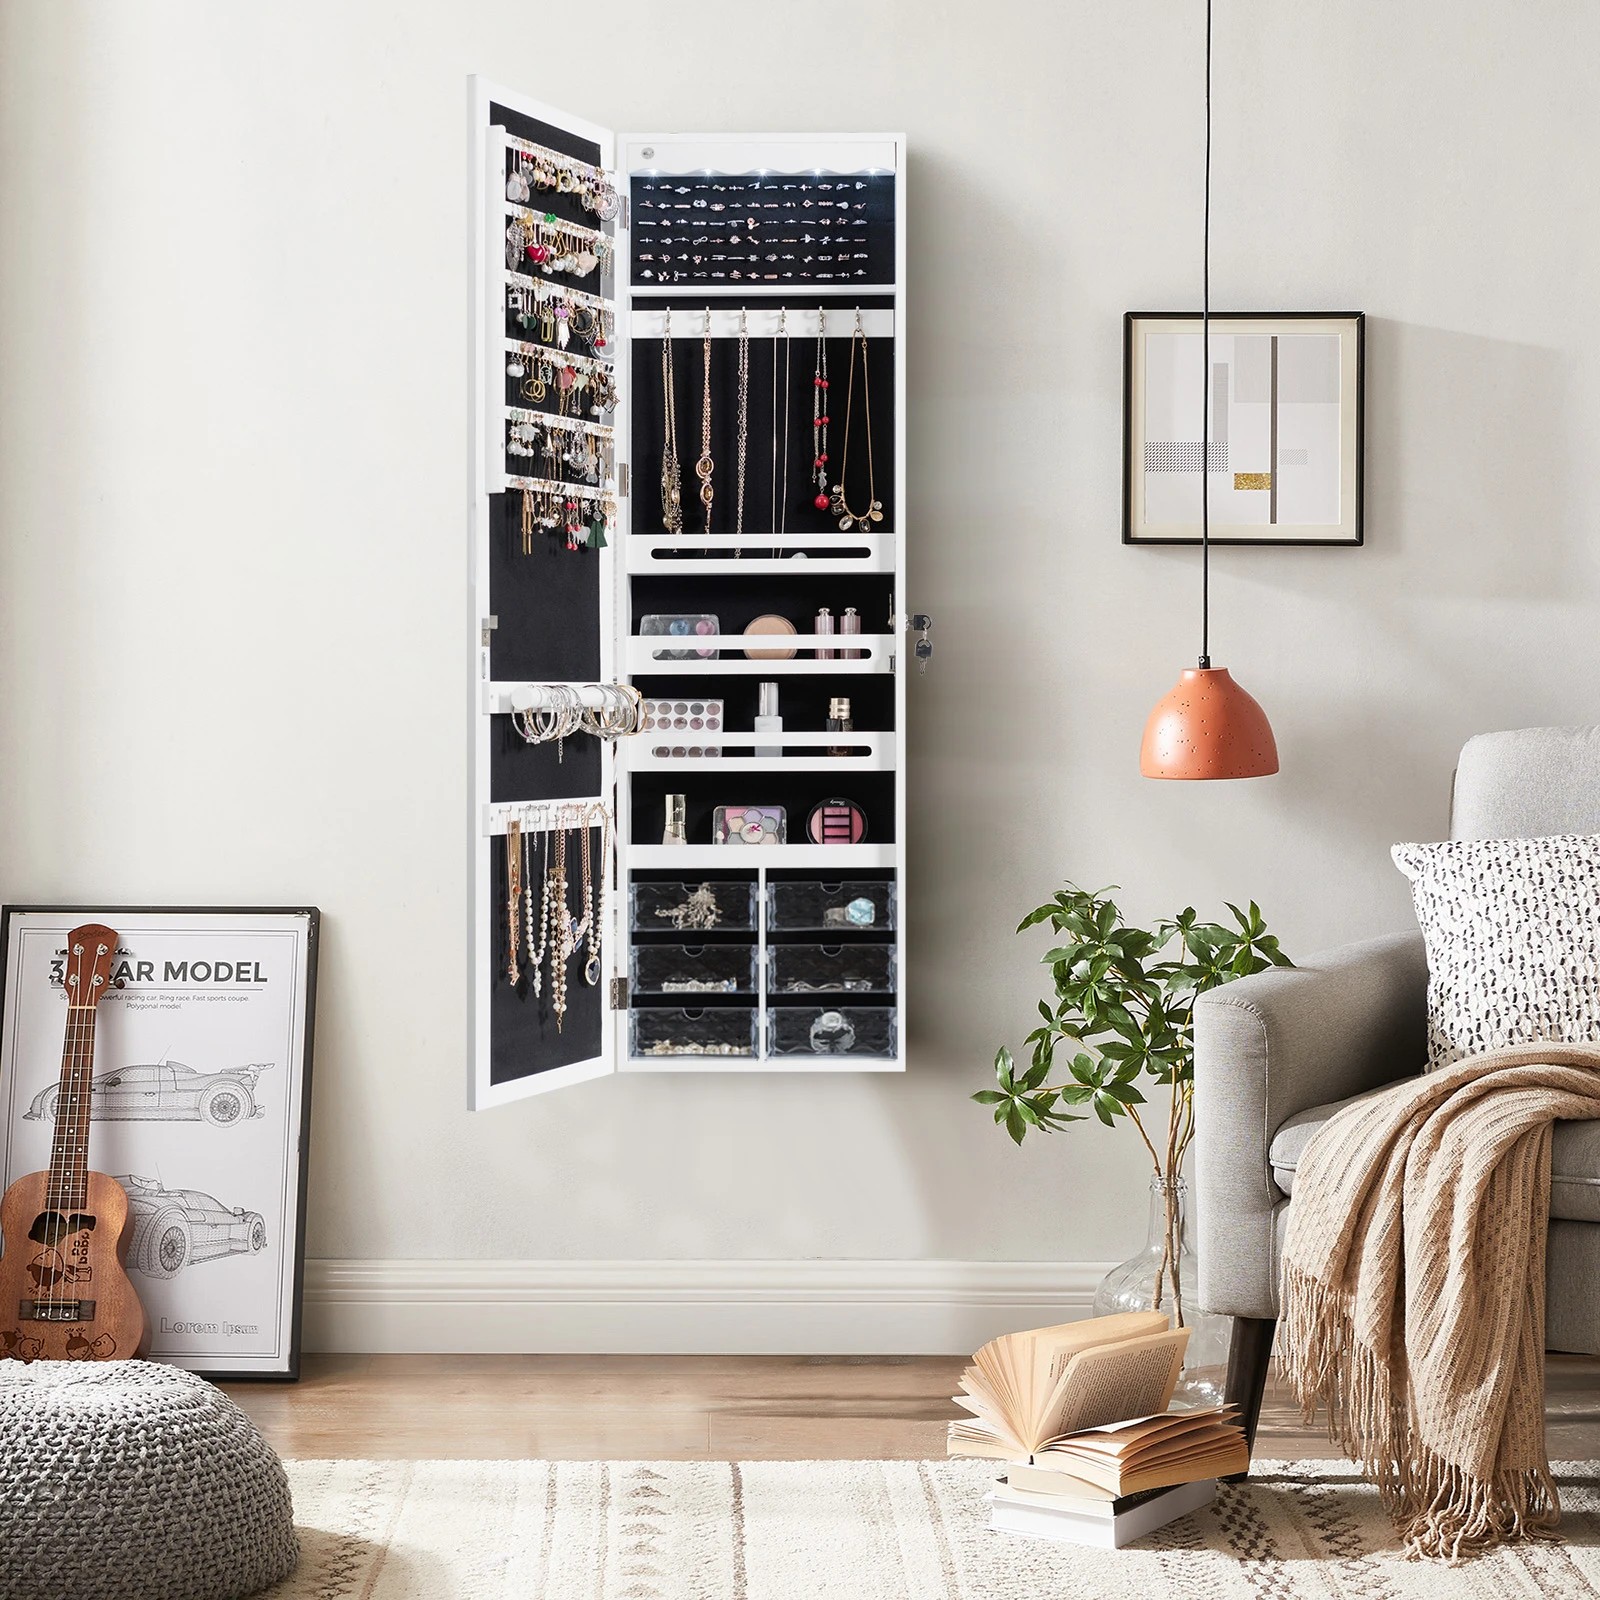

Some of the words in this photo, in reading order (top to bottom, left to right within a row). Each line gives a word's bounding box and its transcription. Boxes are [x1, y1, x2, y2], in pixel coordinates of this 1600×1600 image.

[110, 961, 155, 982] AR
[163, 961, 268, 982] MODEL
[125, 993, 145, 1002] racing
[159, 994, 175, 1002] Ring
[192, 994, 206, 1002] Fast
[206, 995, 227, 1003] sports
[126, 1002, 158, 1010] Polygonal
[160, 1317, 218, 1334] Lorem
